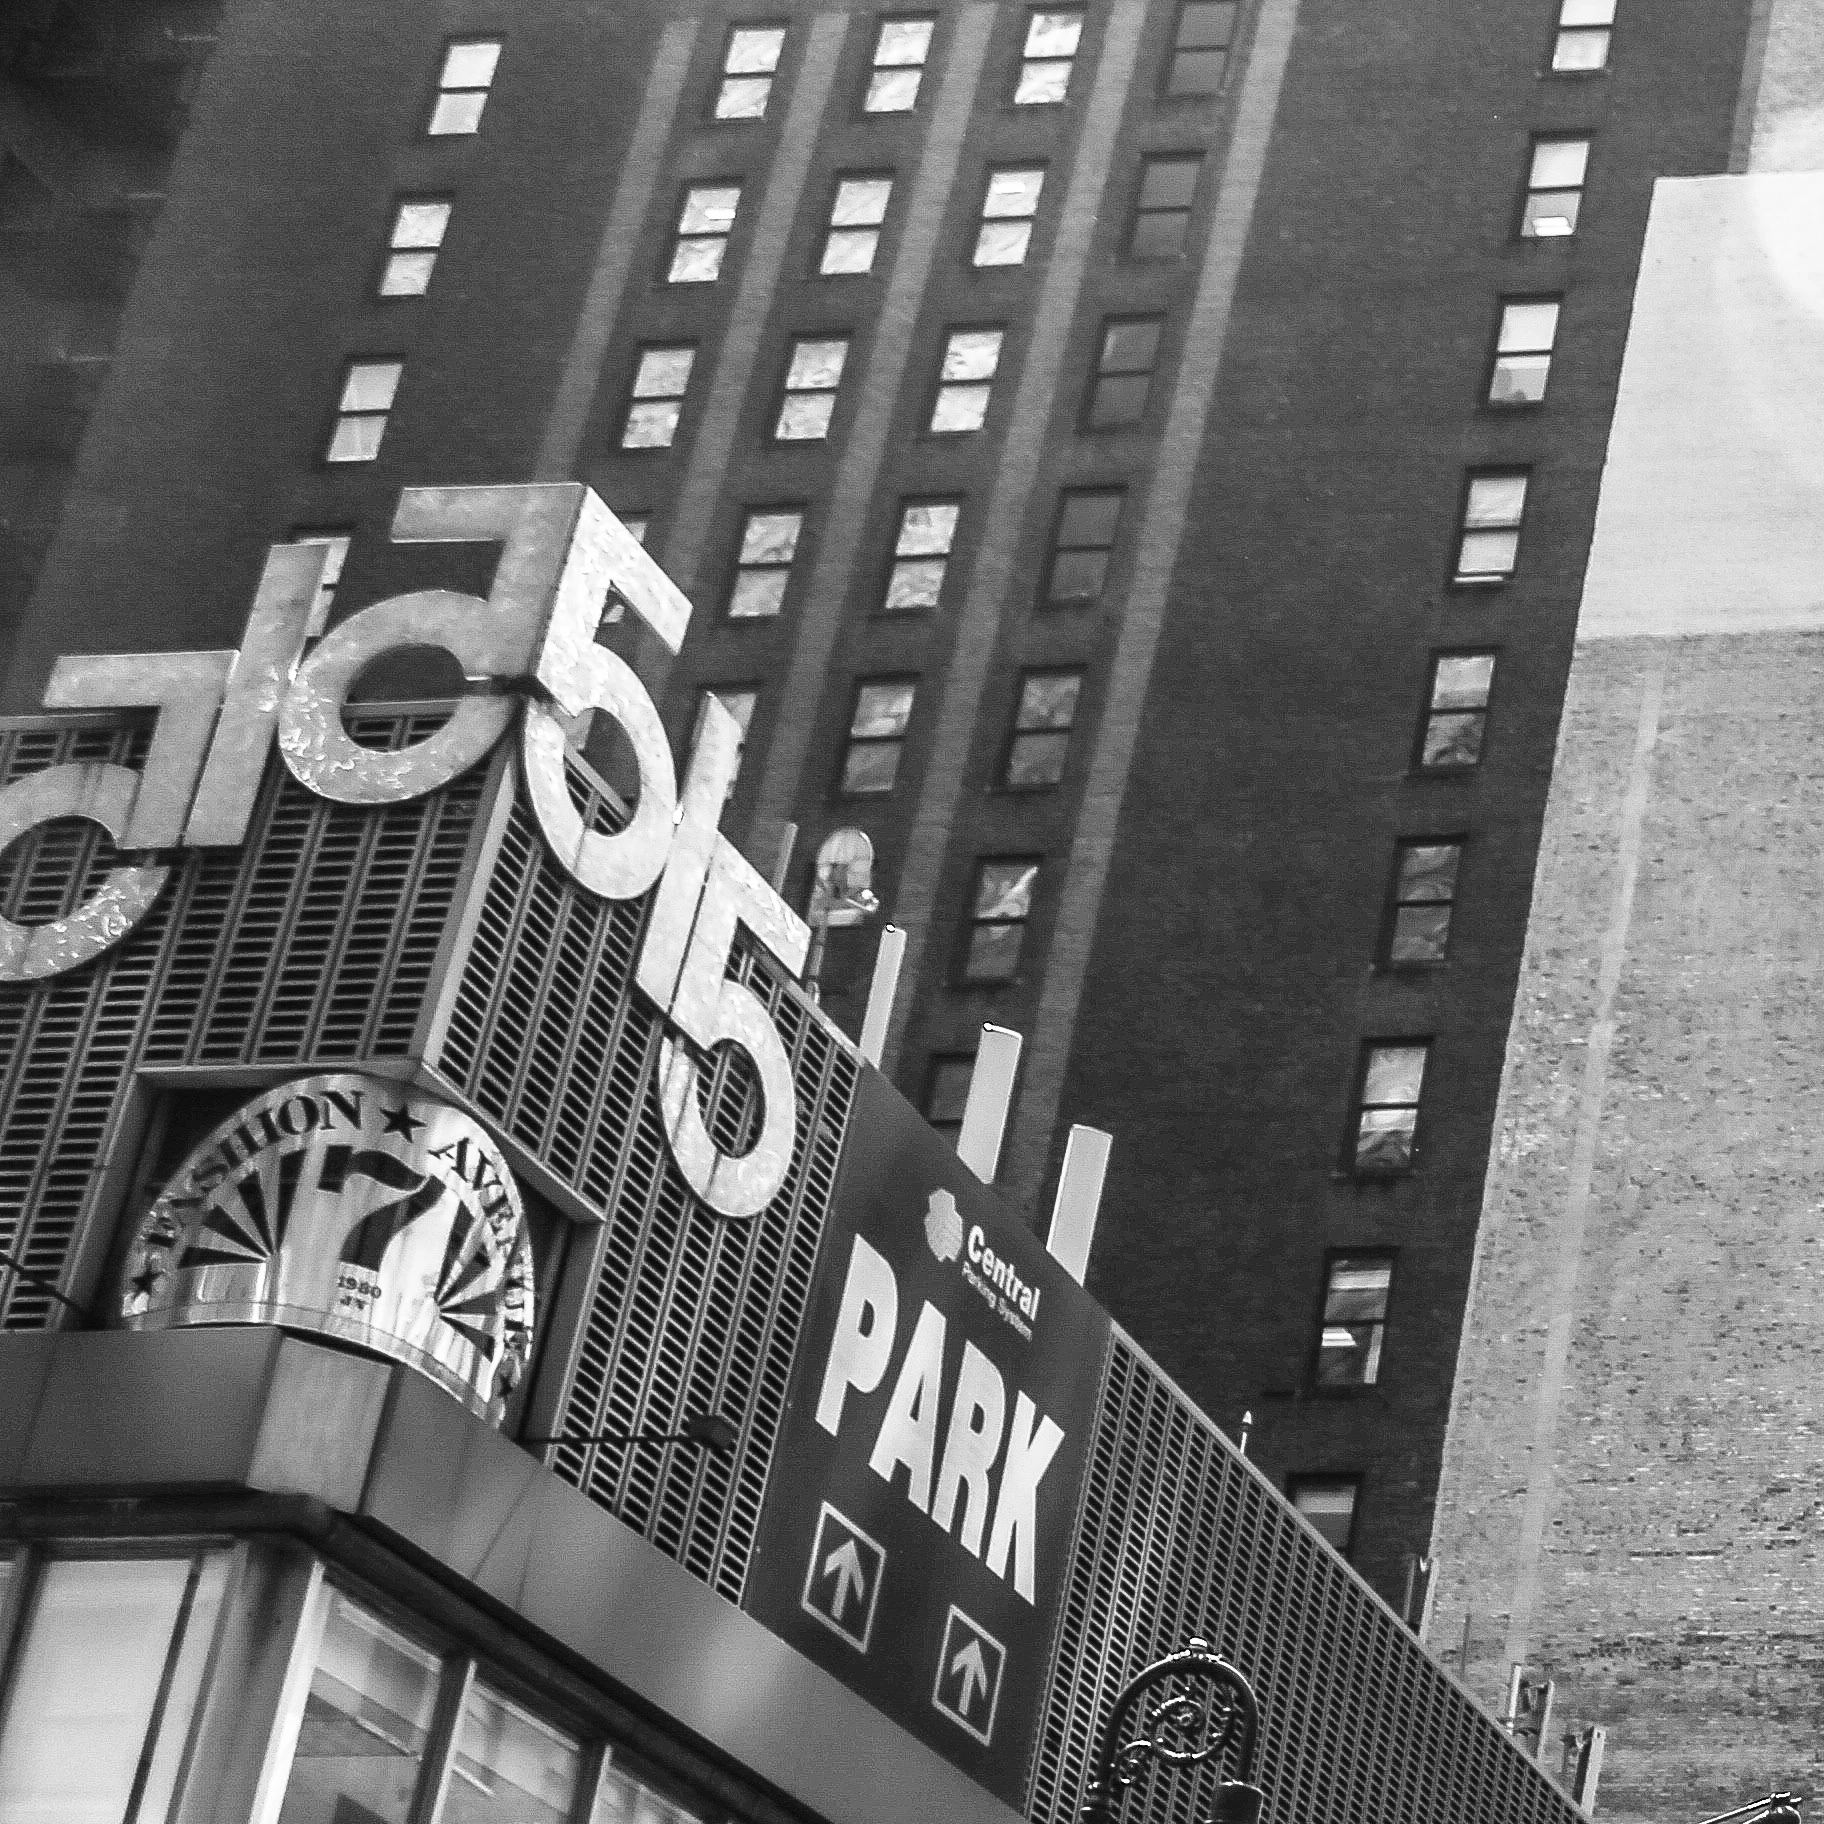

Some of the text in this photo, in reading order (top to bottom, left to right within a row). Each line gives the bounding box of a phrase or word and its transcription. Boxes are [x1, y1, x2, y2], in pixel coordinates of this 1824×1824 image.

[316, 1145, 447, 1272] 7
[968, 1224, 1041, 1322] Central
[815, 1233, 1065, 1606] PARK
